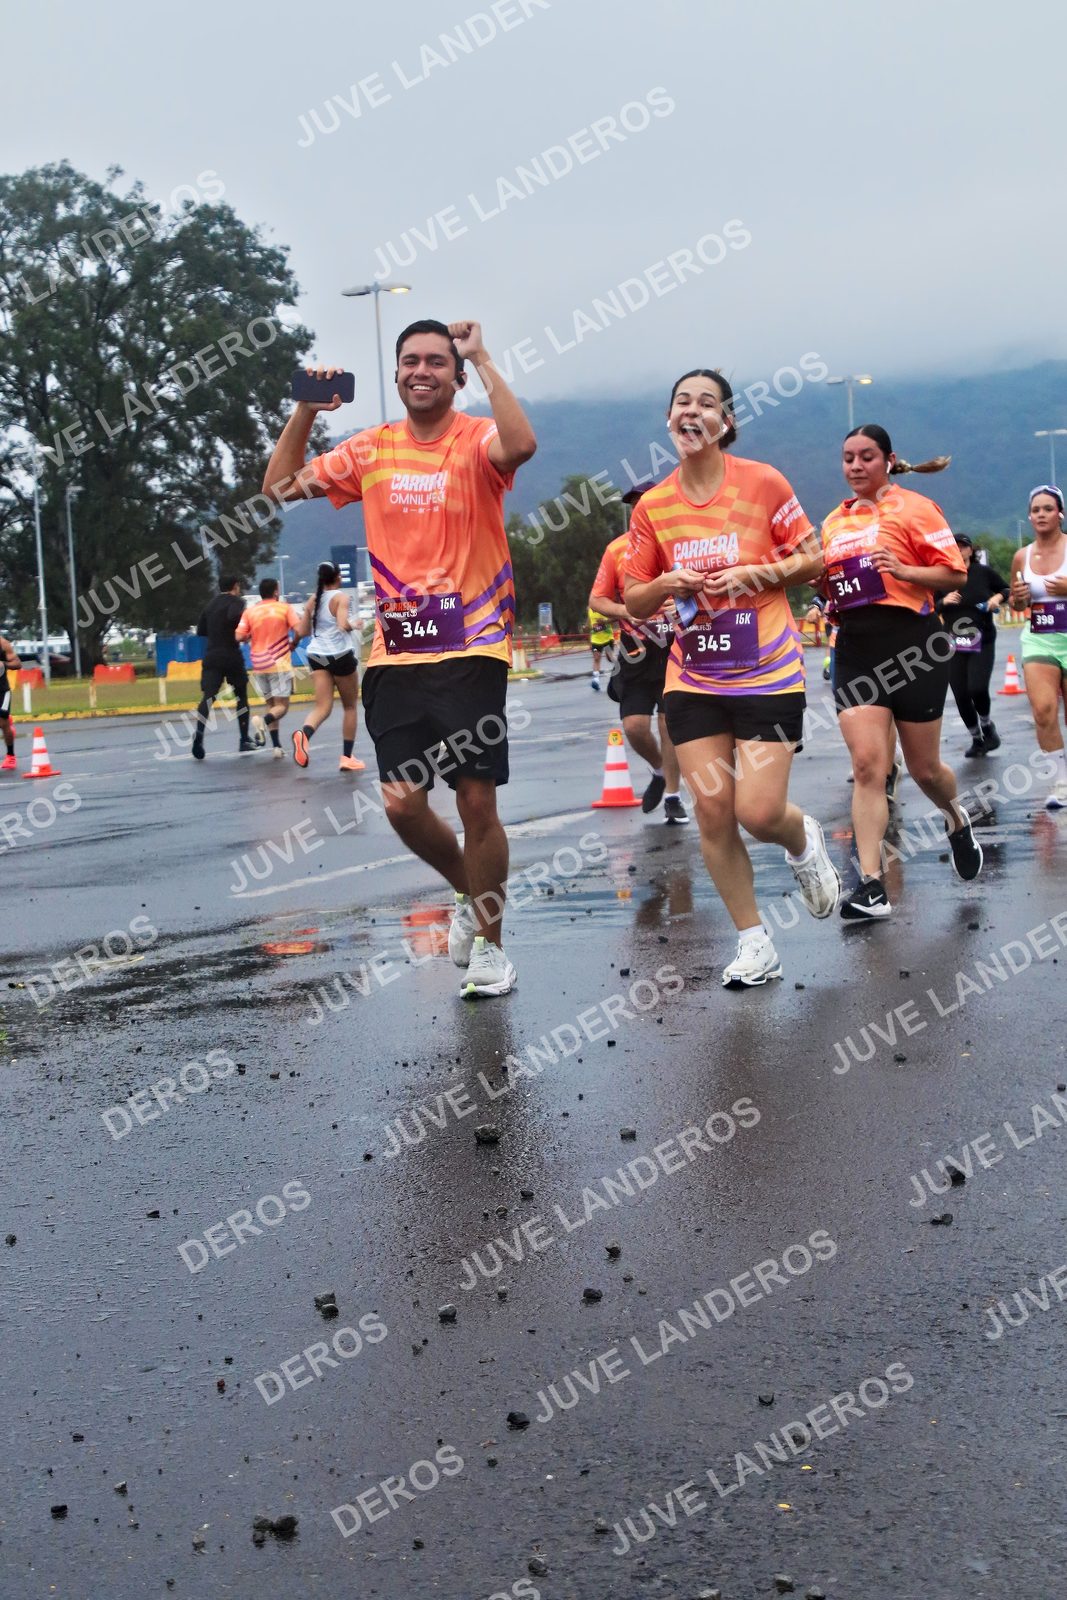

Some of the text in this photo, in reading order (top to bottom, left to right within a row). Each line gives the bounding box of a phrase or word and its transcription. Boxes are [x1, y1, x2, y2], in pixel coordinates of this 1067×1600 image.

[673, 532, 739, 561] CARRERA
[836, 577, 861, 597] 341
[440, 597, 456, 610] 15K
[735, 612, 752, 625] 15K
[1036, 614, 1054, 625] 398
[401, 619, 438, 638] 344
[697, 634, 731, 652] 345
